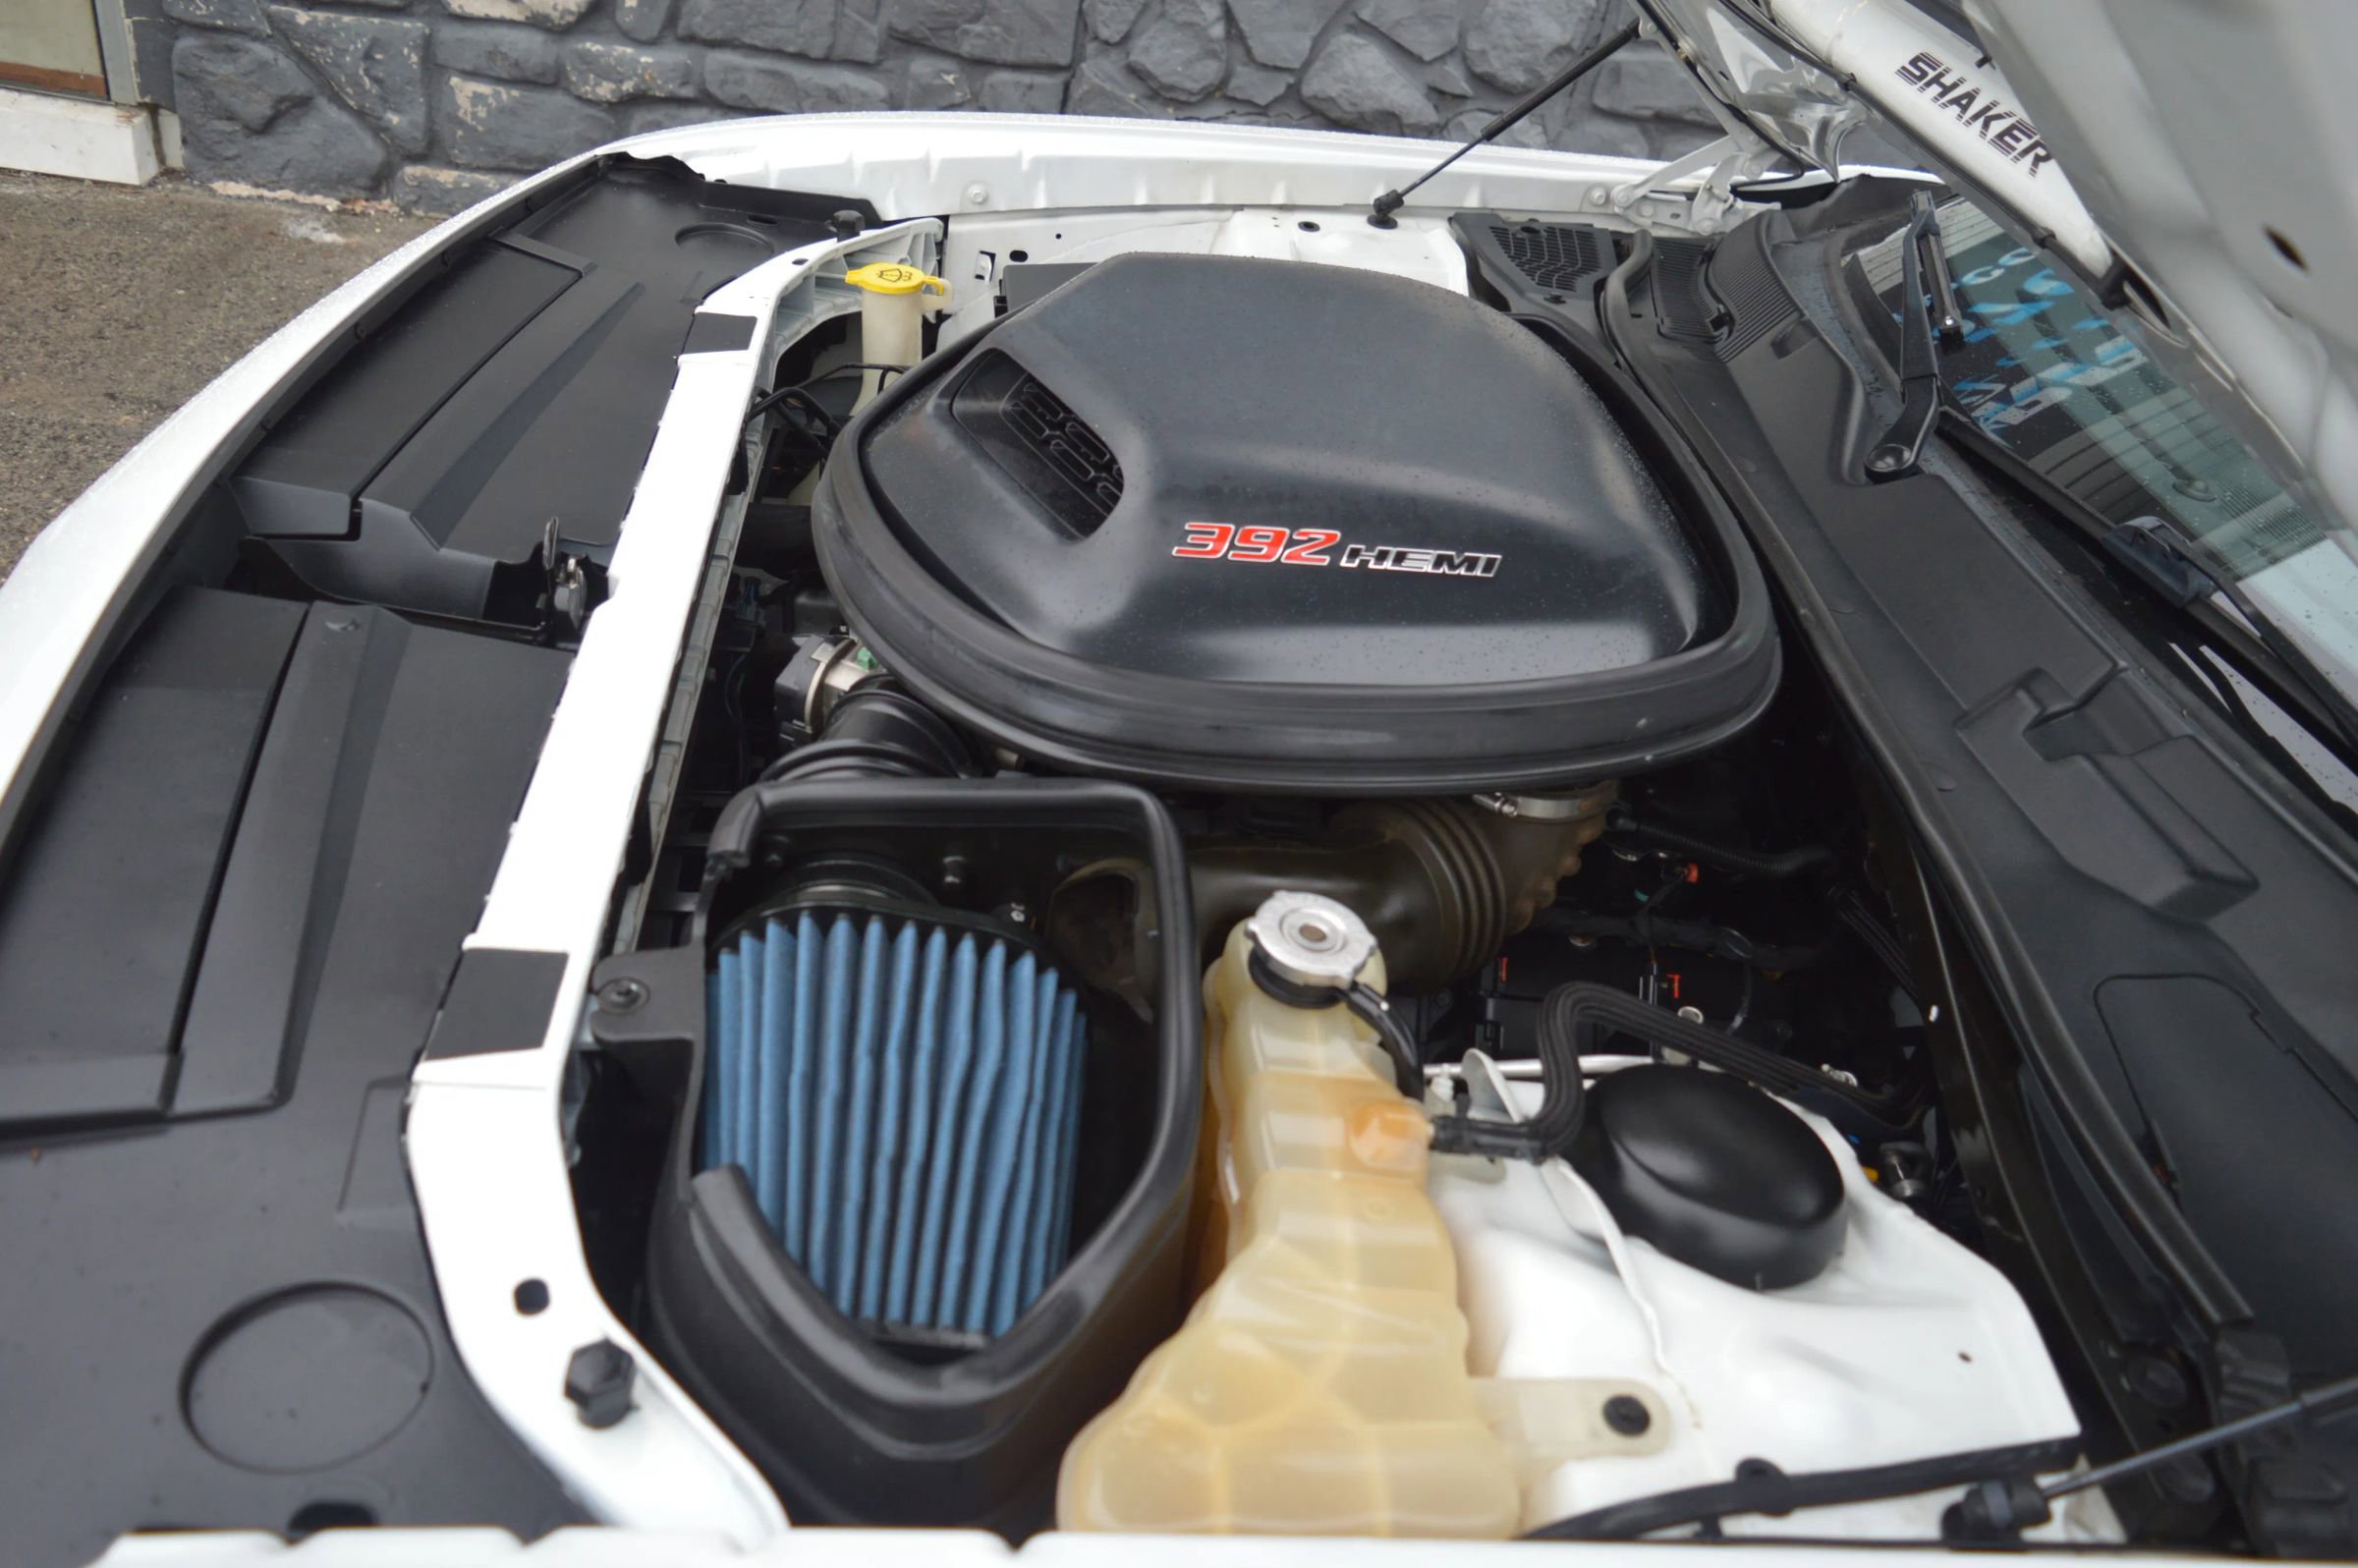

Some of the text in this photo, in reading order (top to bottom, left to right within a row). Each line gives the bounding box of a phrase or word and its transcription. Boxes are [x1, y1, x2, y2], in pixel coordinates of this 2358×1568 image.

[1894, 52, 2053, 178] SHAKER
[1172, 522, 1502, 577] 392 HEMI
